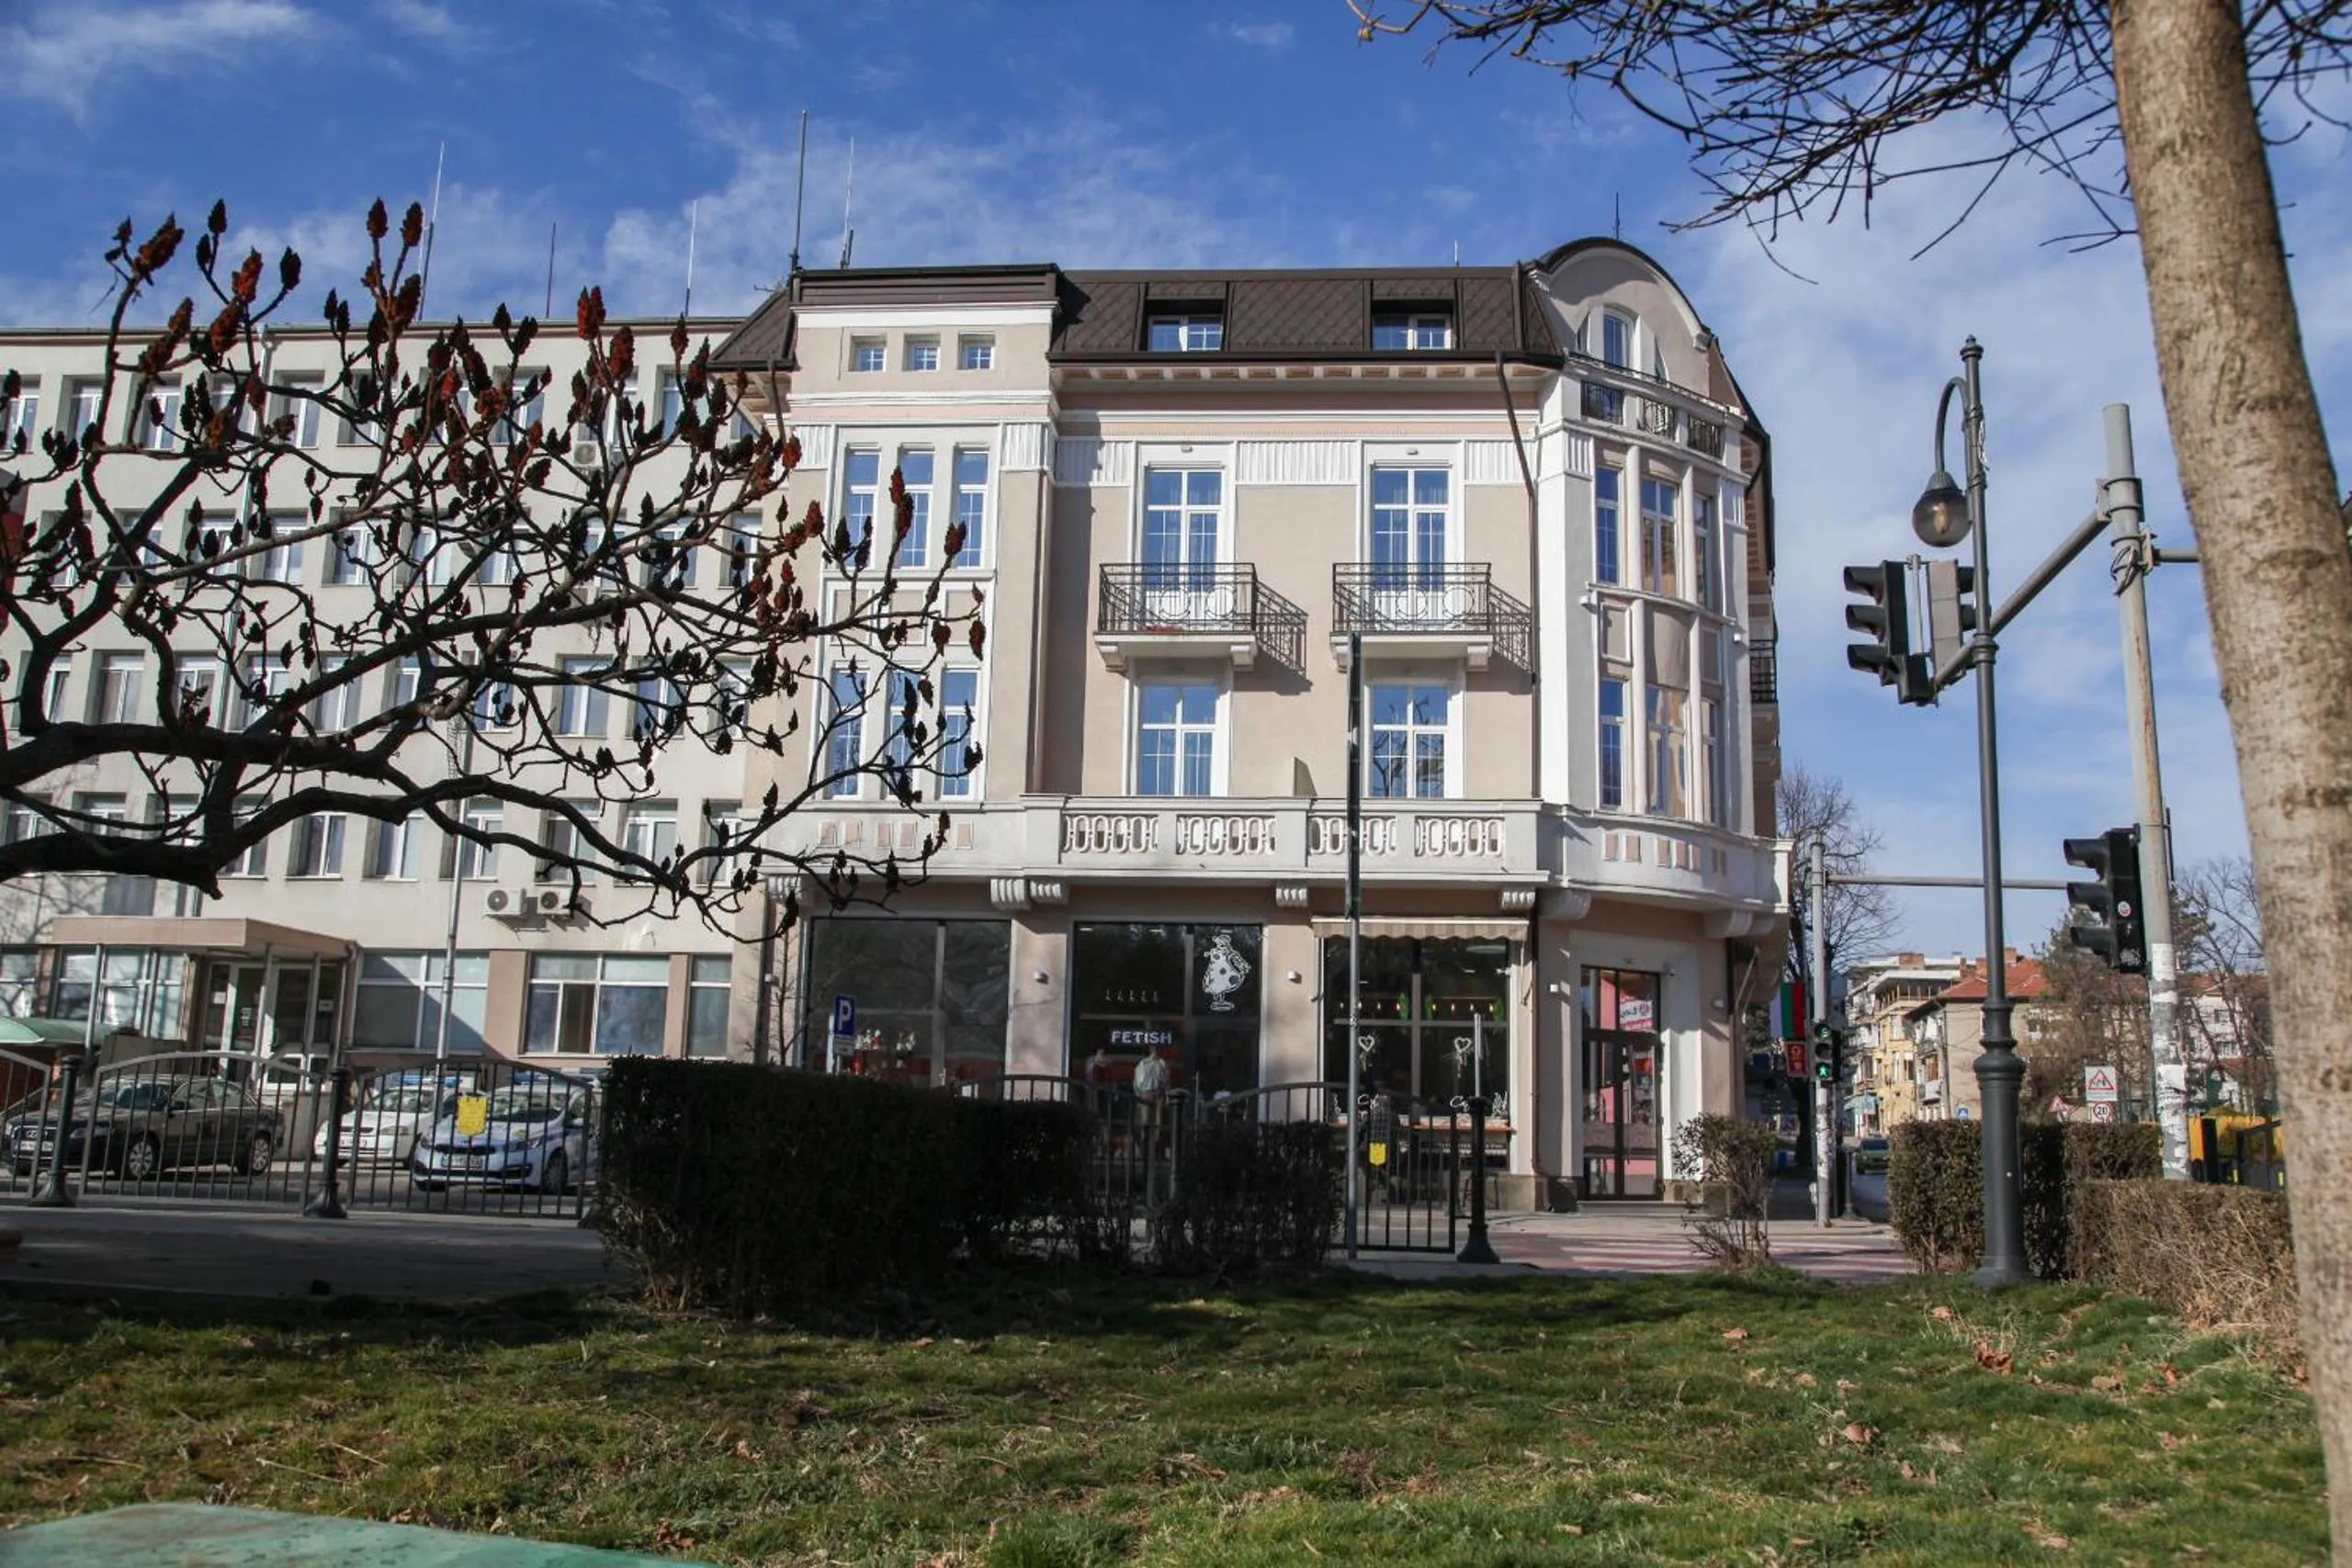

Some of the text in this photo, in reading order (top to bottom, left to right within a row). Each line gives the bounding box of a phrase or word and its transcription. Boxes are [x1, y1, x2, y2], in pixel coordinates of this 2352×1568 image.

[838, 998, 853, 1031] P
[1111, 1031, 1172, 1043] FETISH
[2097, 1106, 2109, 1115] 20
